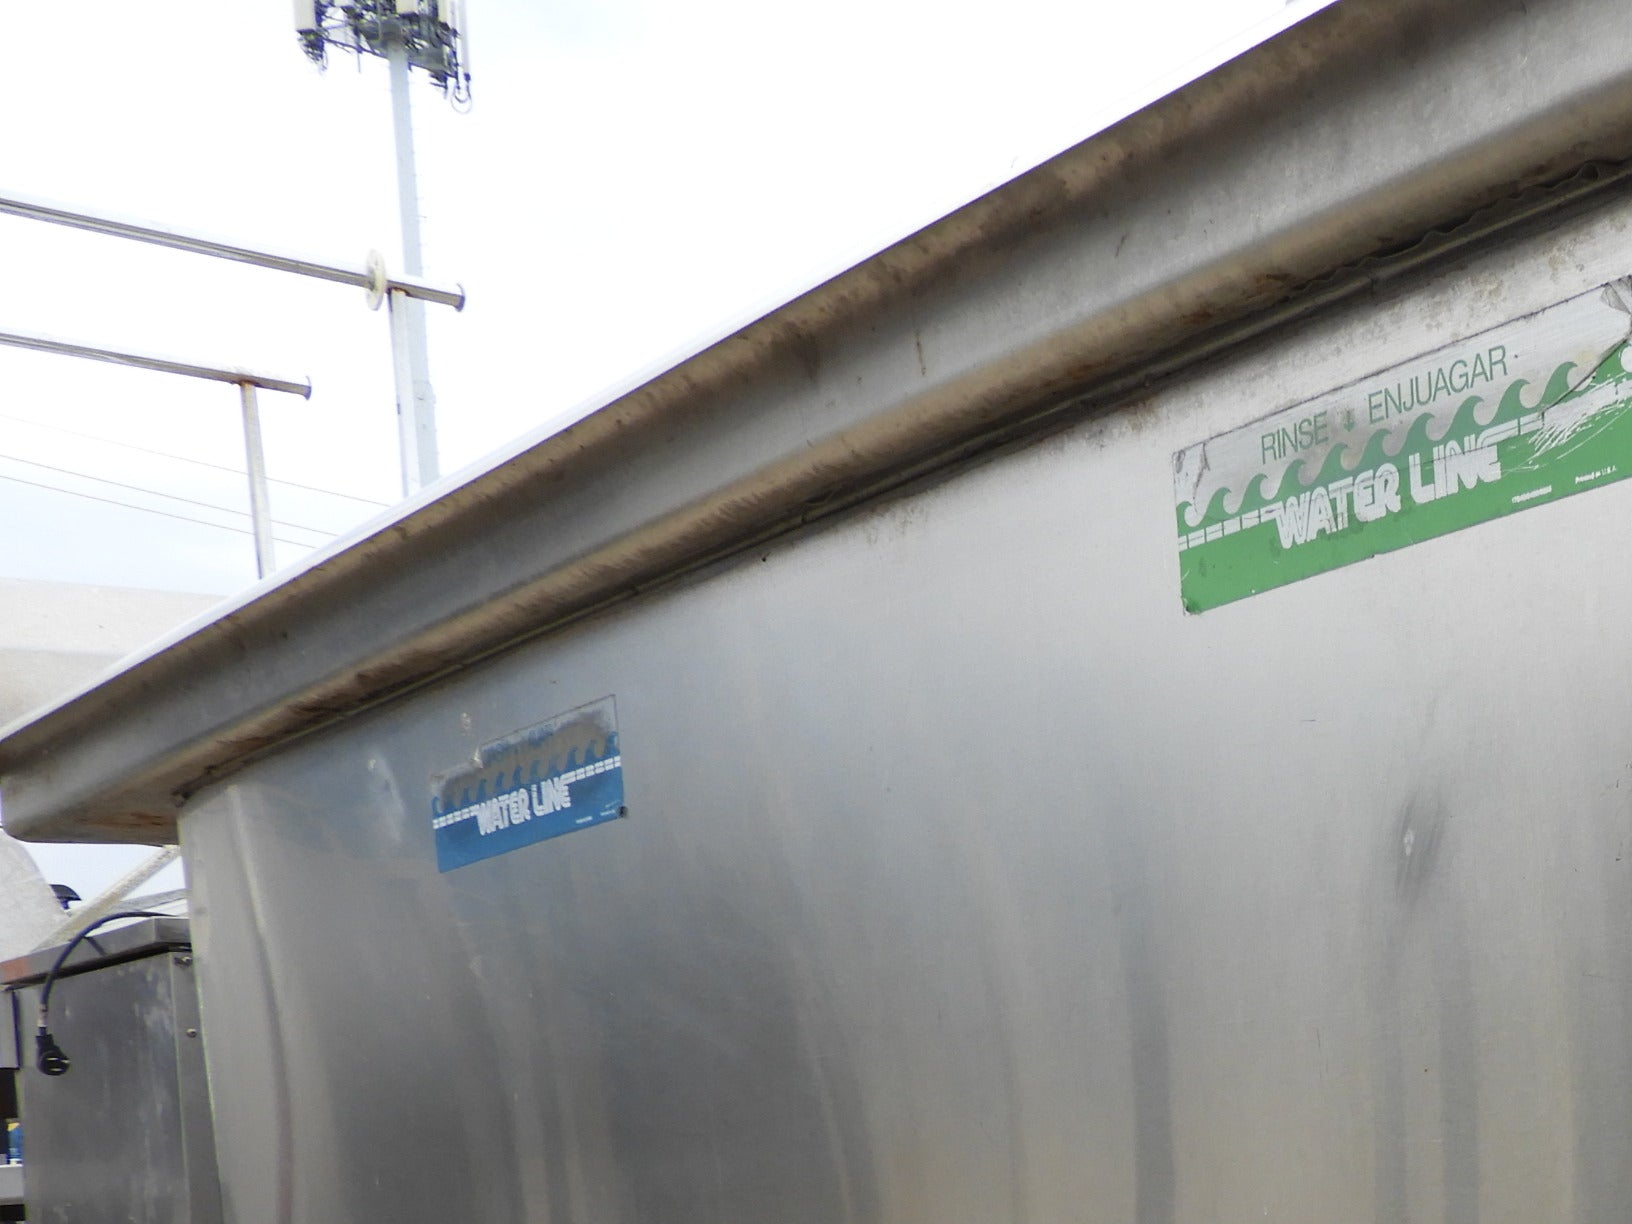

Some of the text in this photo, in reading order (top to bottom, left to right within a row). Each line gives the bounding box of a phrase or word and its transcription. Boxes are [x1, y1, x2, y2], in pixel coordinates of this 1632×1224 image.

[1261, 344, 1508, 465] RINSE ENJUAGAR
[1261, 418, 1519, 550] WATER LINE
[469, 771, 576, 837] WATER LINE
